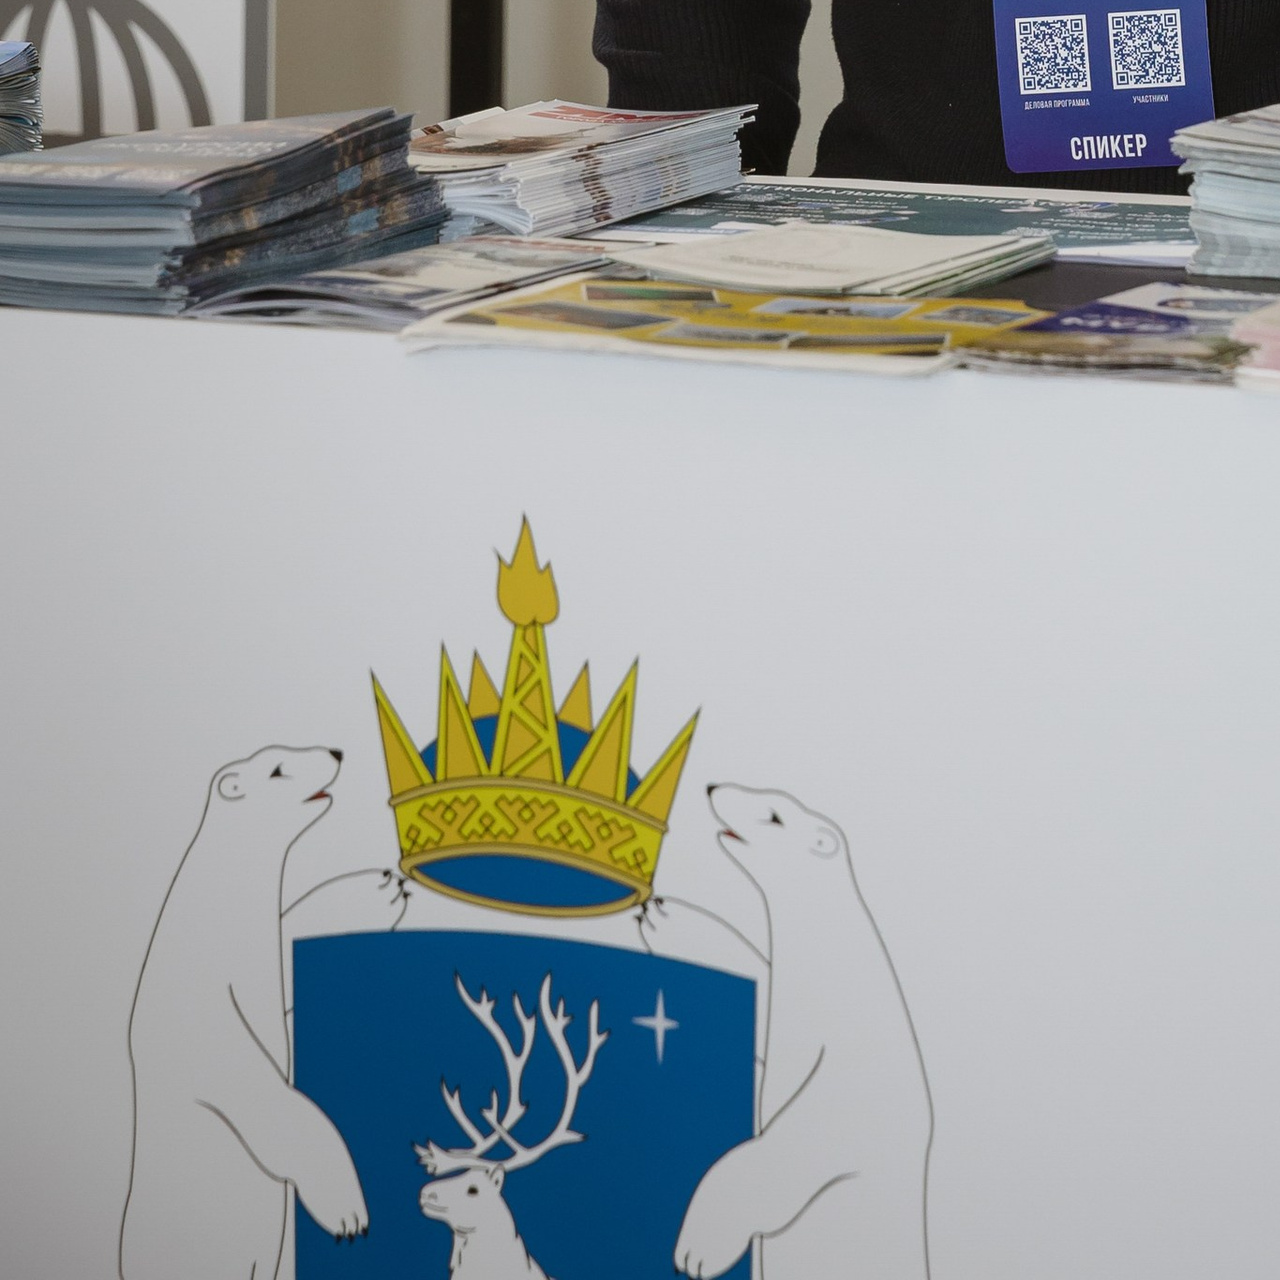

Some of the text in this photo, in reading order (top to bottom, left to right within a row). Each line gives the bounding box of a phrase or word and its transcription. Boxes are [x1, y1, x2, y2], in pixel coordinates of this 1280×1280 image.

[1024, 98, 1091, 110] ДЕЛОВАЯ ПРОГРАММА
[1132, 94, 1169, 104] УЧАСТНИКИ
[1070, 133, 1148, 161] СПИКЕР
